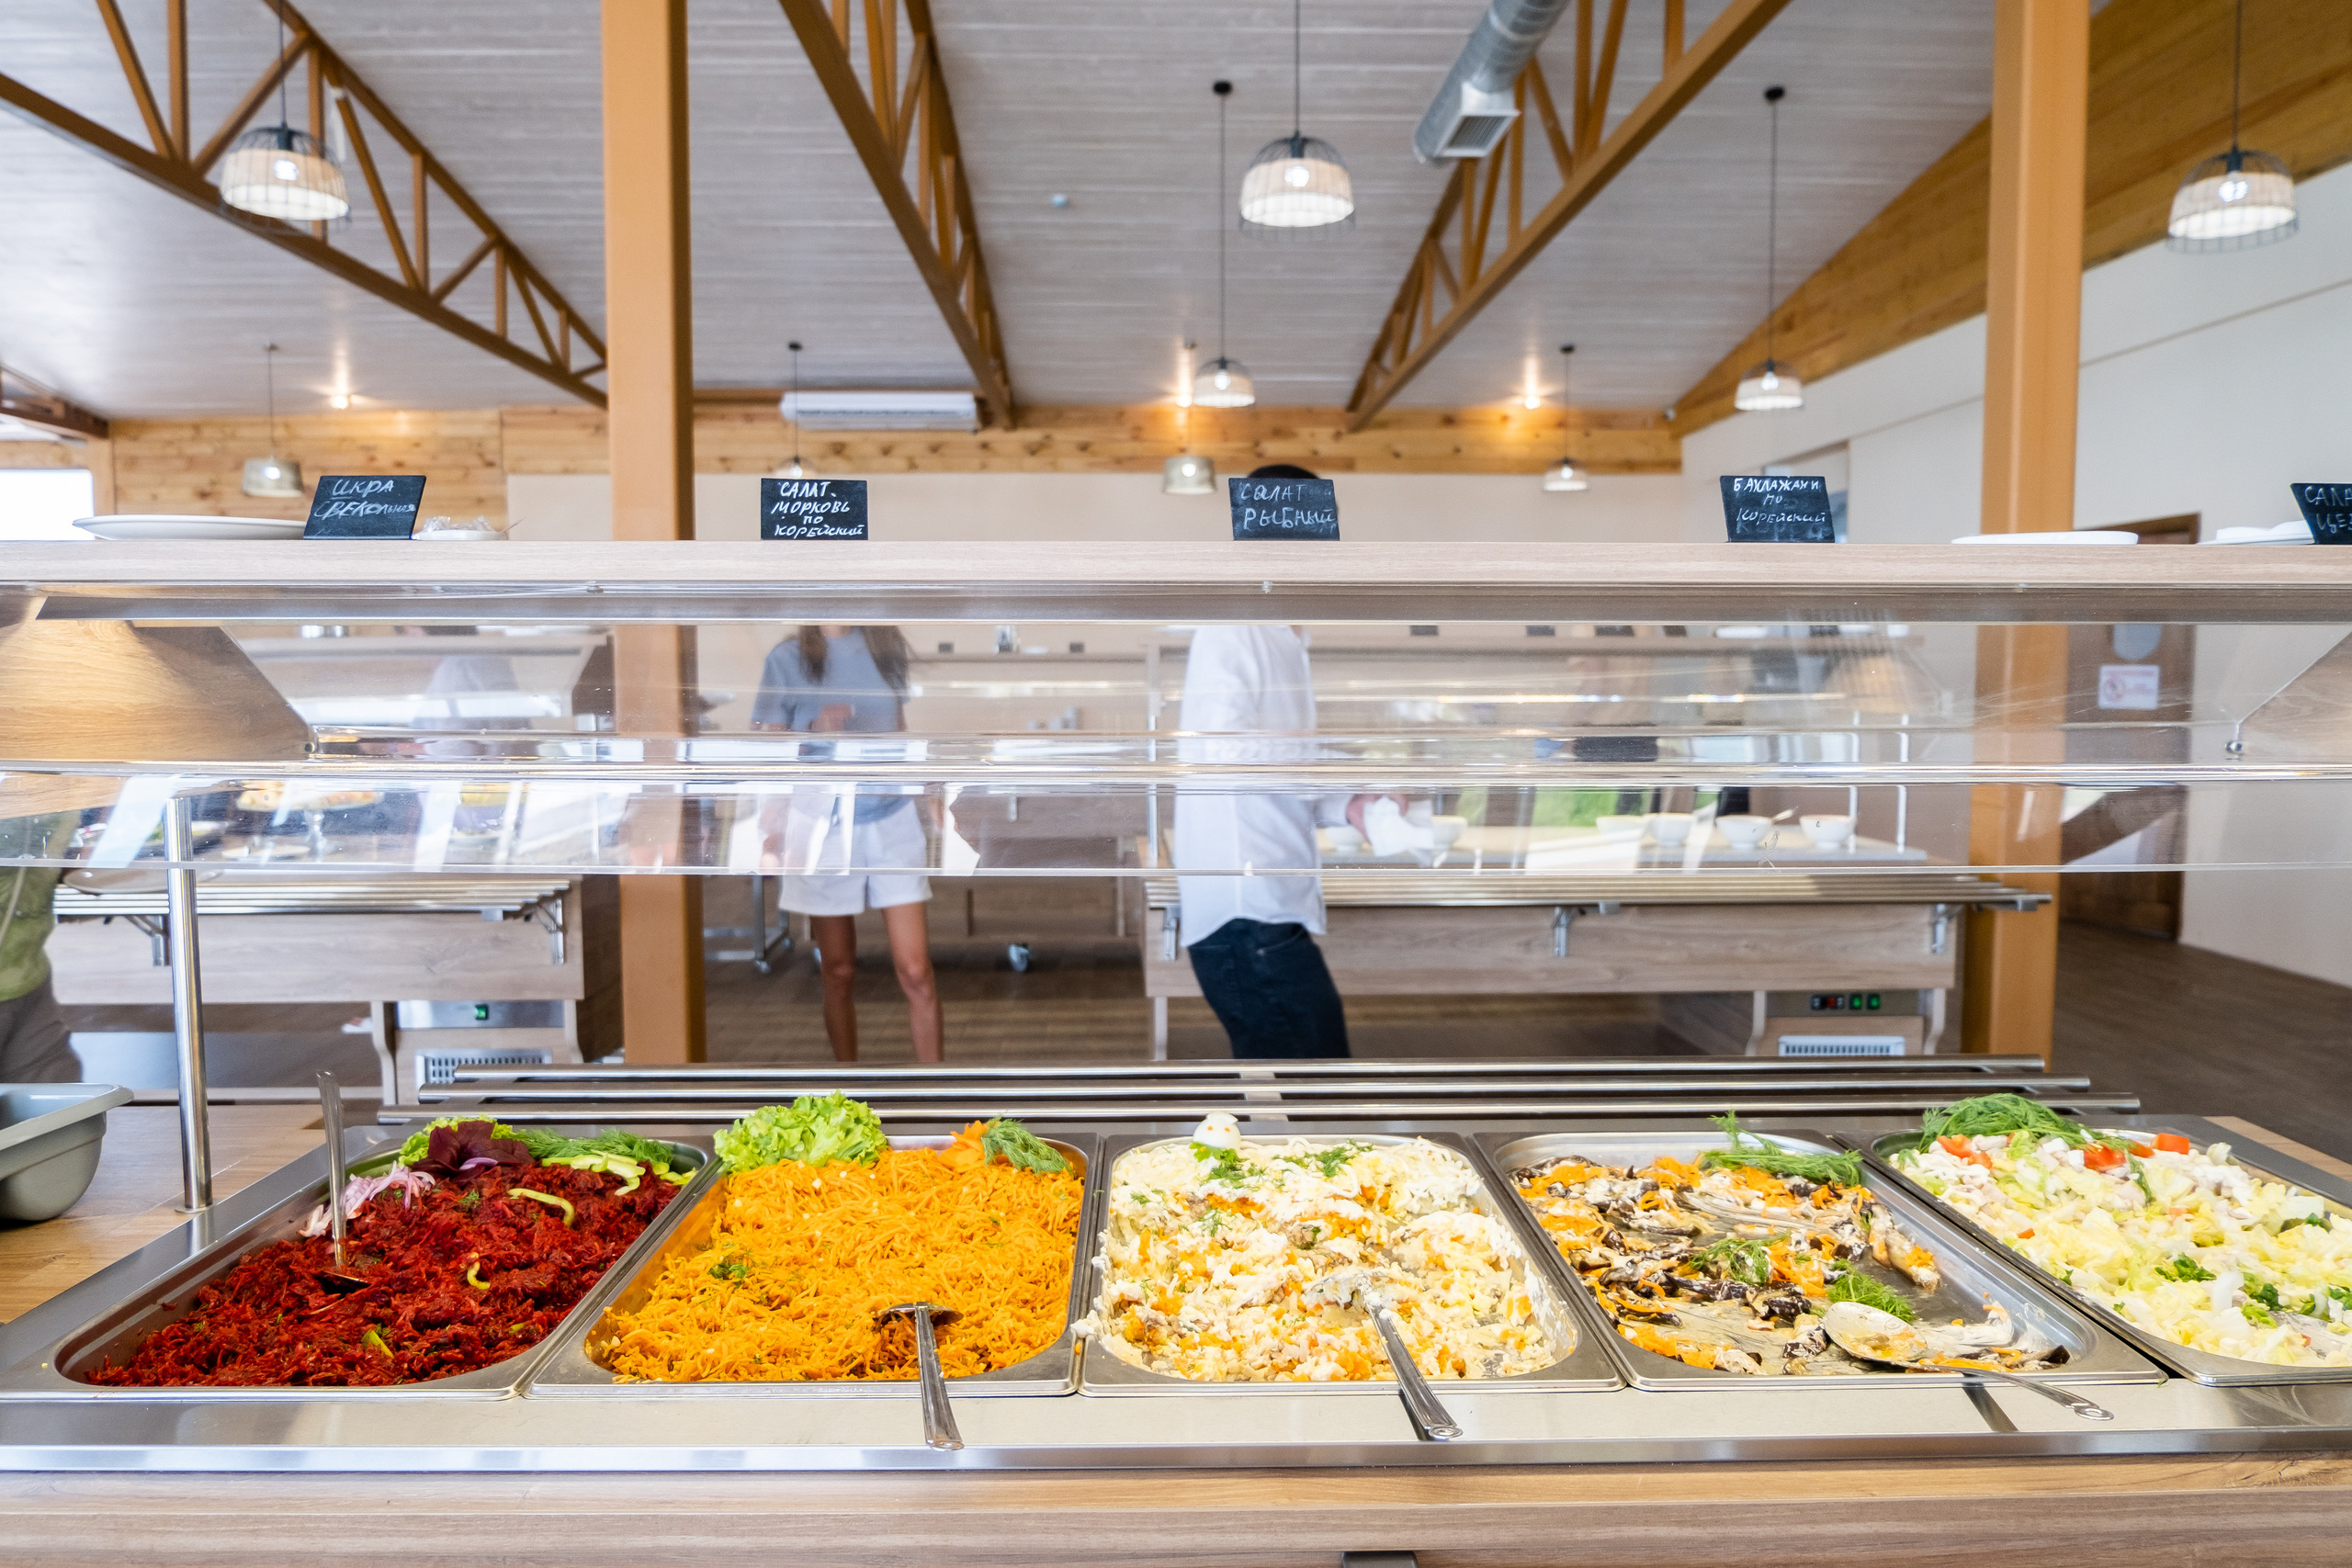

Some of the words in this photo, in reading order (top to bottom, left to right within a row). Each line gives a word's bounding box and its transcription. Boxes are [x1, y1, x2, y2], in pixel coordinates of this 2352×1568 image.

[332, 479, 395, 498] ИКРА
[771, 501, 851, 515] МОРКОВЬ
[802, 515, 824, 525] ПО
